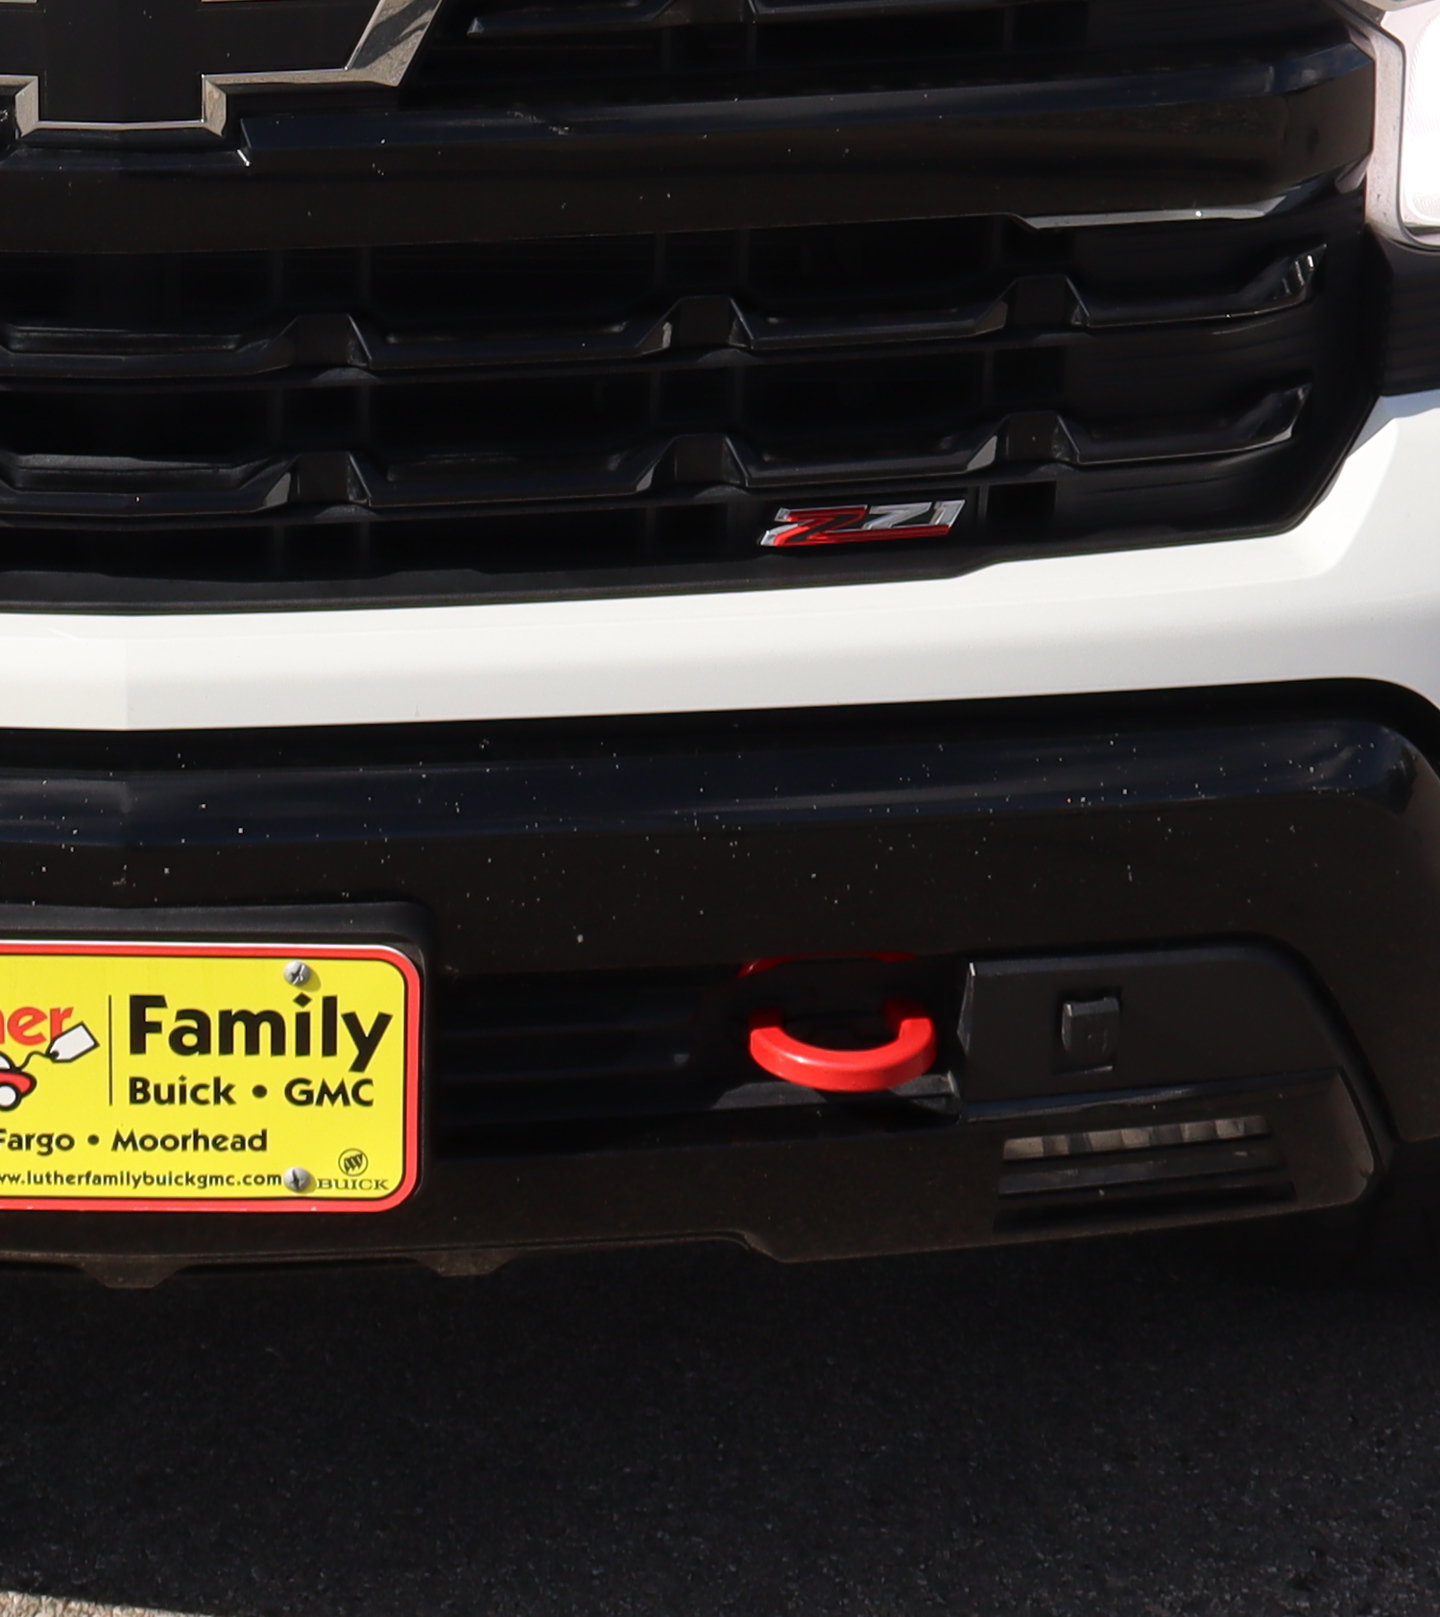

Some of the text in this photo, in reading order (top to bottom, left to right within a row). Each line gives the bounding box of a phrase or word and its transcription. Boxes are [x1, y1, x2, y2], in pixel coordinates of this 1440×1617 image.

[759, 498, 966, 548] Z71
[128, 992, 394, 1073] Family
[128, 1074, 375, 1108] Buick GMC
[110, 1128, 269, 1153] Moorhead
[315, 1177, 390, 1191] BUICK
